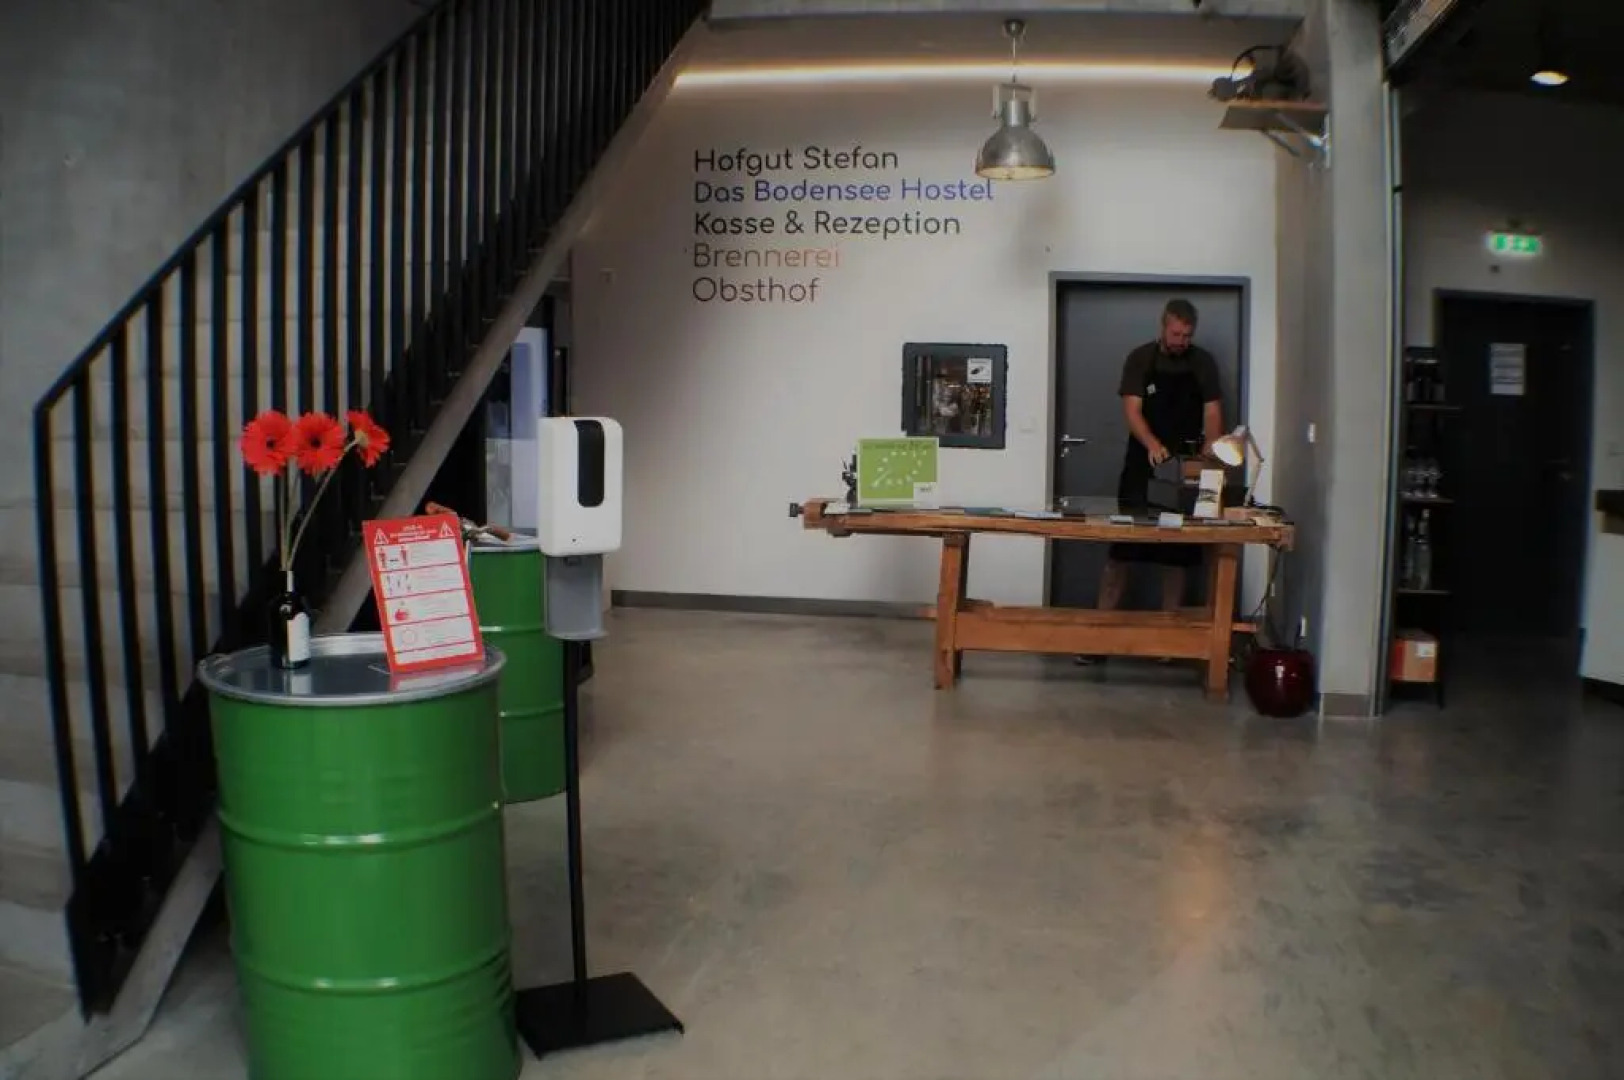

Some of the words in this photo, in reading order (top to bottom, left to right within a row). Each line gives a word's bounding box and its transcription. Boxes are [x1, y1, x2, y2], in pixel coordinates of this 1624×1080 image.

[695, 147, 793, 176] Hofgut
[804, 146, 898, 170] Stefan
[695, 182, 744, 203] Das
[755, 179, 891, 202] Bodensee
[902, 178, 994, 201] Hostel
[695, 212, 774, 236] Kasse
[785, 210, 804, 235] &
[815, 211, 961, 239] Rezeption
[694, 243, 840, 267] Brennerei
[693, 277, 821, 303] Obsthof
